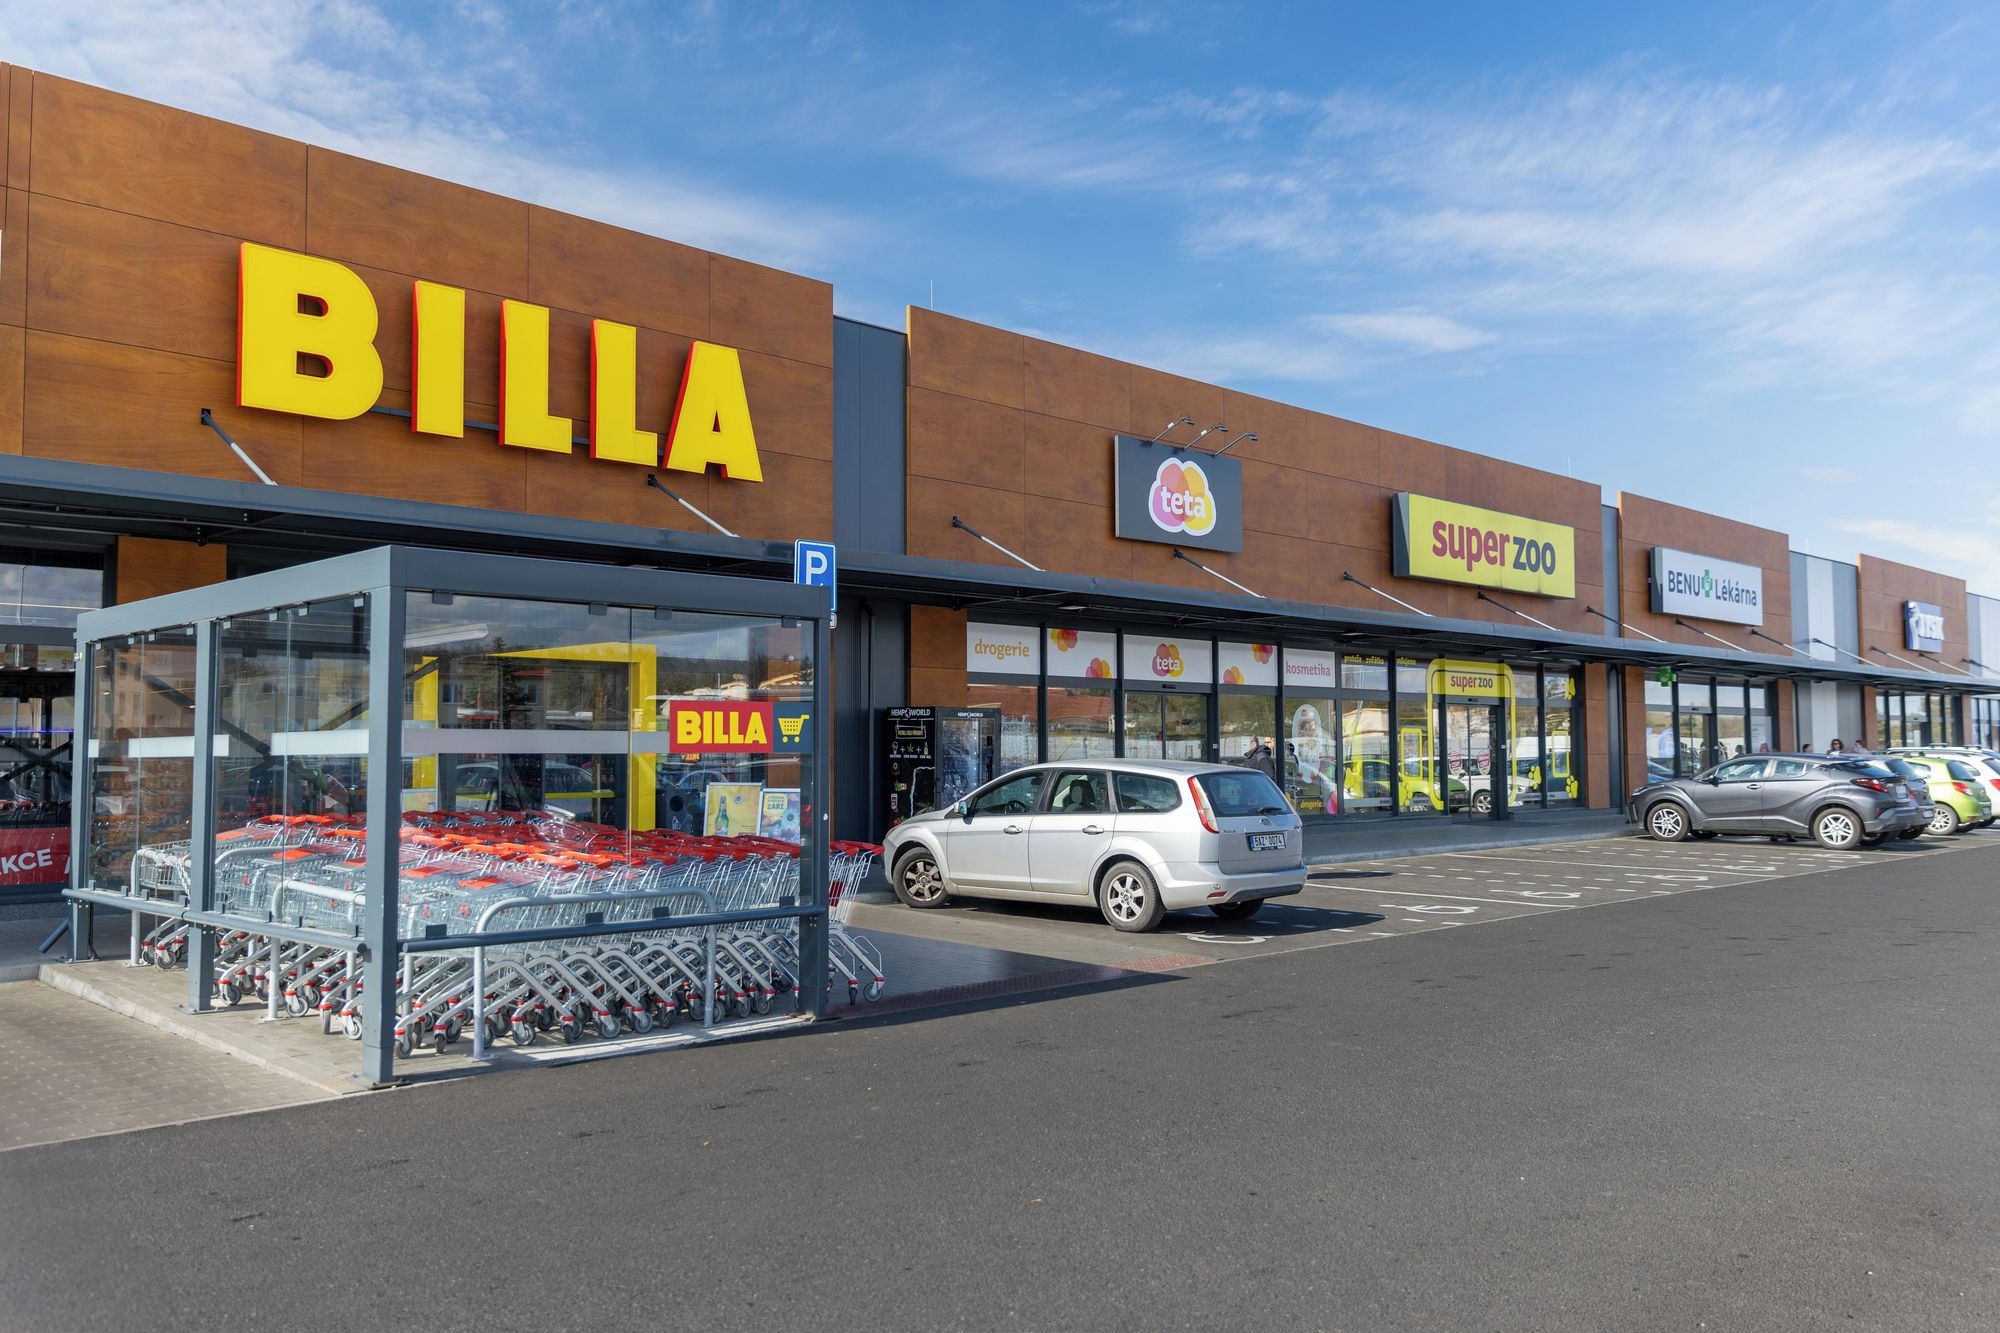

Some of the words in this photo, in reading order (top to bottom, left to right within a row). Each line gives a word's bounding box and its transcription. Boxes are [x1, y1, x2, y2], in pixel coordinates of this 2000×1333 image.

[236, 242, 763, 482] BILLA
[1160, 486, 1206, 517] teta
[805, 550, 828, 585] P
[1668, 570, 1700, 597] BENU
[1715, 579, 1758, 606] Lékárna
[974, 639, 1030, 660] drogerie
[1156, 655, 1180, 671] teta
[1286, 661, 1331, 676] kosmetika
[910, 708, 931, 716] WORLD
[677, 711, 767, 744] BILLA
[1300, 800, 1322, 809] drogerie
[0, 848, 53, 874] KCE
